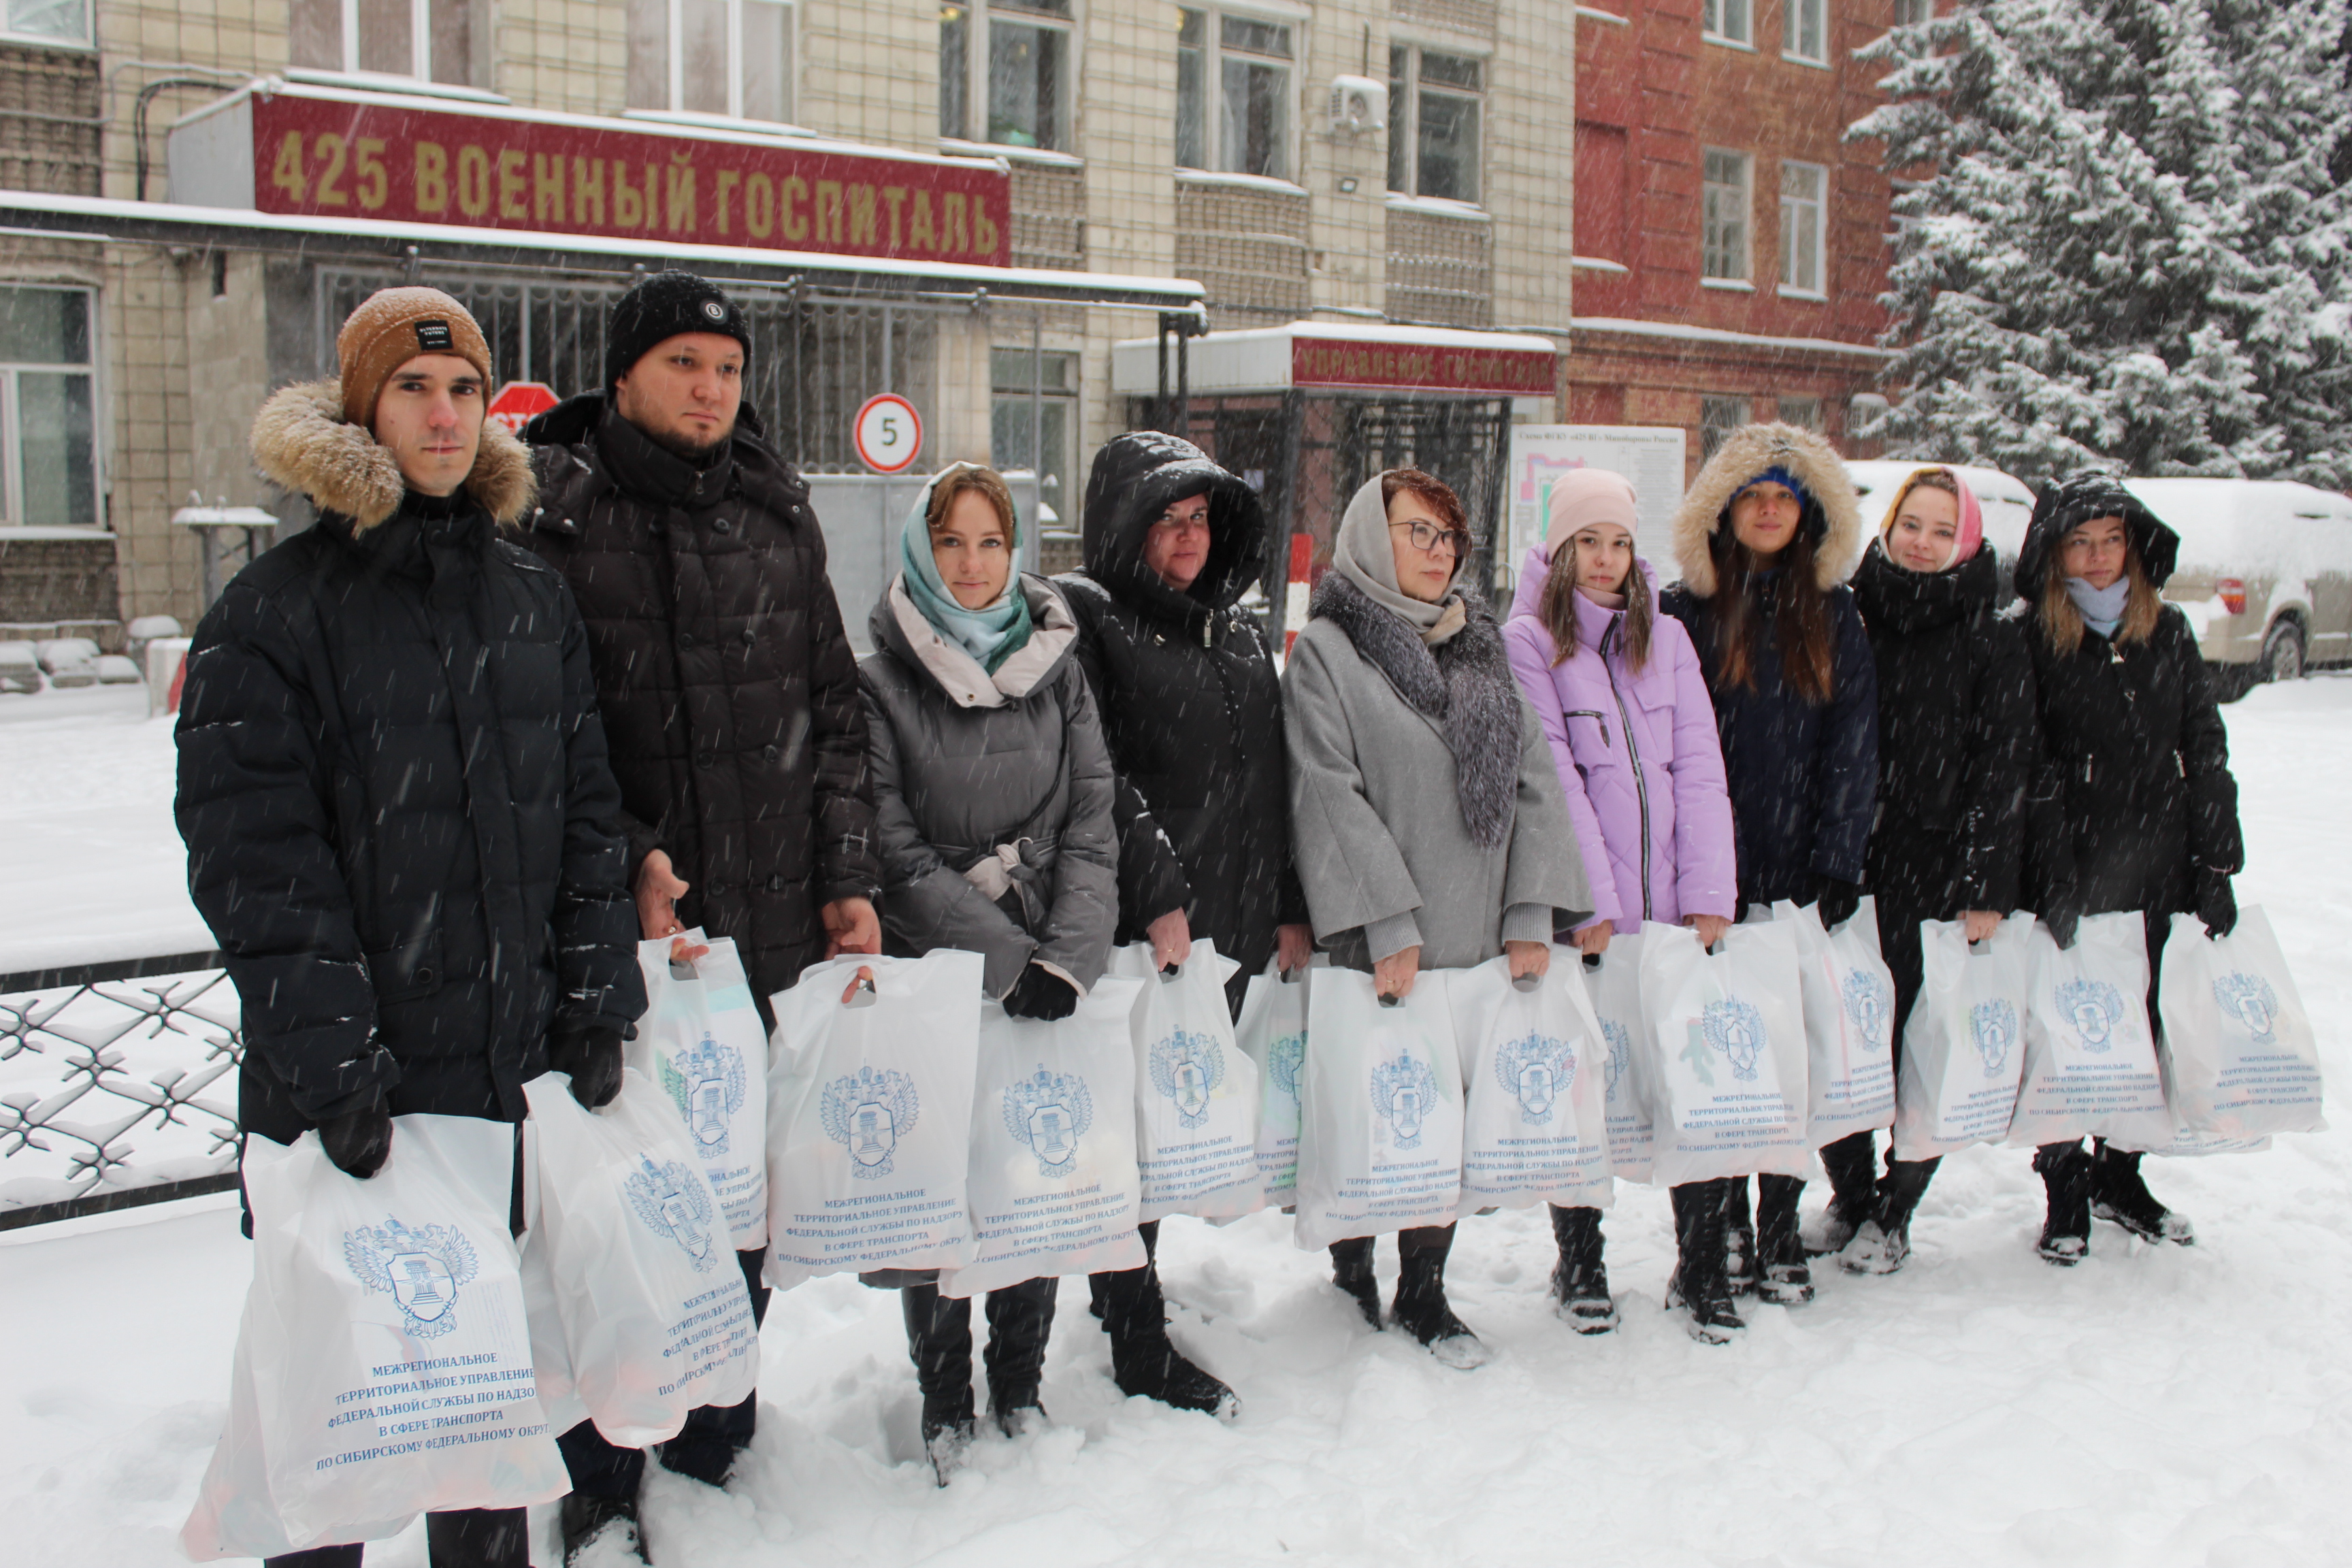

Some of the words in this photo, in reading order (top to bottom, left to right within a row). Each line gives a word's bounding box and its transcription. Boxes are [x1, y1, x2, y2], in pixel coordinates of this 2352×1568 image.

[274, 130, 388, 210] 425
[416, 141, 696, 233] ВОЕННЫЙ
[717, 169, 998, 255] ГОСПИТАЛЬ
[1301, 348, 1435, 381] УПРАВЛЕНИЕ
[882, 416, 897, 446] 5
[1520, 432, 1543, 440] Схема
[1654, 434, 1679, 443] России
[2065, 1062, 2134, 1071] МЕЖРЕГИОНАЛЬНОЕ
[2042, 1075, 2112, 1083] ТЕРРИТОРИАЛЬНОЕ
[2113, 1073, 2155, 1081] УПРАВЛЕНИЕ
[2036, 1085, 2091, 1094] ФЕДЕРАЛЬНОЙ
[2097, 1095, 2138, 1103] ТРАНСПОРТА
[1688, 1105, 1763, 1116] ТЕРРИТОРИАЛЬНОЕ
[1683, 1116, 1740, 1129] ФЕДЕРАЛЬНОЙ
[1742, 1116, 1773, 1125] СЛУЖБЫ
[1497, 1135, 1578, 1146] МЕЖРЕГИОНАЛЬНОЕ
[1721, 1130, 1746, 1138] СФЕРЕ
[1472, 1149, 1550, 1158] ТЕРРИТОРИАЛЬНОЕ
[1551, 1145, 1599, 1156] УПРАВЛЕНИЕ
[1689, 1142, 1741, 1152] СИБИРСКОМУ
[1141, 1169, 1183, 1182] ЕРАЛЬНОЙ
[1218, 1161, 1228, 1170] ПО
[1258, 1160, 1297, 1171] ЕРАЛЬНОЙ
[1372, 1158, 1439, 1173] МЕЖРЕГИОНАЛЬНОЕ
[1465, 1161, 1524, 1171] ФЕДЕРАЛЬНОЙ
[1526, 1160, 1560, 1169] СЛУЖБЫ
[1278, 1172, 1296, 1180] СФЕР
[1345, 1174, 1417, 1186] ТЕРРИТОРИАЛЬНОЕ
[1531, 1171, 1580, 1181] ТРАНСПОРТА
[1161, 1182, 1187, 1191] СФЕРЕ
[1338, 1188, 1394, 1198] ФЕДЕРАЛЬНОЙ
[1394, 1186, 1424, 1195] СЛУЖБЫ
[1470, 1183, 1522, 1194] СИБИРСКОМУ
[824, 1188, 926, 1209] МЕЖРЕГИОНАЛЬНОЕ
[1013, 1183, 1101, 1207] МЕЖРЕГИОНАЛЬНОЕ
[1141, 1195, 1180, 1204] ИРСКОМУ
[1397, 1195, 1439, 1206] ТРАНСПОРТА
[794, 1208, 892, 1223] ТЕРРИТОРИАЛЬНОЕ
[894, 1198, 957, 1215] УПРАВЛЕНИЕ
[984, 1205, 1073, 1224] ТЕРРИТОРИАЛЬНОЕ
[1075, 1192, 1126, 1211] УПРАВЛЕНИЕ
[1389, 1206, 1445, 1218] ФЕДЕРАЛЬНОМУ
[786, 1225, 858, 1238] ФЕДЕРАЛЬНОЙ
[860, 1220, 904, 1234] СЛУЖБЫ
[906, 1218, 921, 1227] ПО
[922, 1211, 964, 1226] НАДЗОРУ
[977, 1222, 1044, 1239] ФЕДЕРАЛЬНОЙ
[1045, 1215, 1083, 1229] СЛУЖБЫ
[1085, 1213, 1096, 1222] ПО
[824, 1243, 832, 1252] В
[833, 1239, 864, 1251] СФЕРЕ
[866, 1231, 930, 1247] ТРАНСПОРТА
[1022, 1235, 1050, 1246] СФЕРЕ
[1050, 1224, 1102, 1241] ТРАНСПОРТА
[778, 1253, 792, 1262] ПО
[794, 1254, 858, 1266] СИБИРСКОМУ
[860, 1242, 938, 1261] ФЕДЕРАЛЬНОМУ
[940, 1235, 966, 1248] ОКРУ
[981, 1246, 1043, 1263] СИБИРСКОМУ
[693, 1352, 700, 1362] В
[372, 1352, 497, 1377] МЕЖРЕГИОНАЛЬНОЕ
[335, 1376, 457, 1406] ТЕРРИТОРИАЛЬНОЕ
[460, 1368, 534, 1386] УПРАВЛЕНИЕ
[658, 1383, 675, 1396] ПО
[328, 1398, 420, 1428] ФЕДЕРАЛЬНОЙ
[421, 1393, 474, 1410] СЛУЖБЫ
[477, 1391, 494, 1403] ПО
[497, 1386, 536, 1401] НАДЗО
[378, 1426, 387, 1437] В
[390, 1419, 429, 1435] СФЕРЕ
[431, 1409, 504, 1428] ТРАНСПОРТА
[316, 1456, 333, 1471] ПО
[335, 1440, 423, 1465] СИБИРСКОМУ
[425, 1427, 516, 1450] ФЕДЕРАЛЬНОМУ
